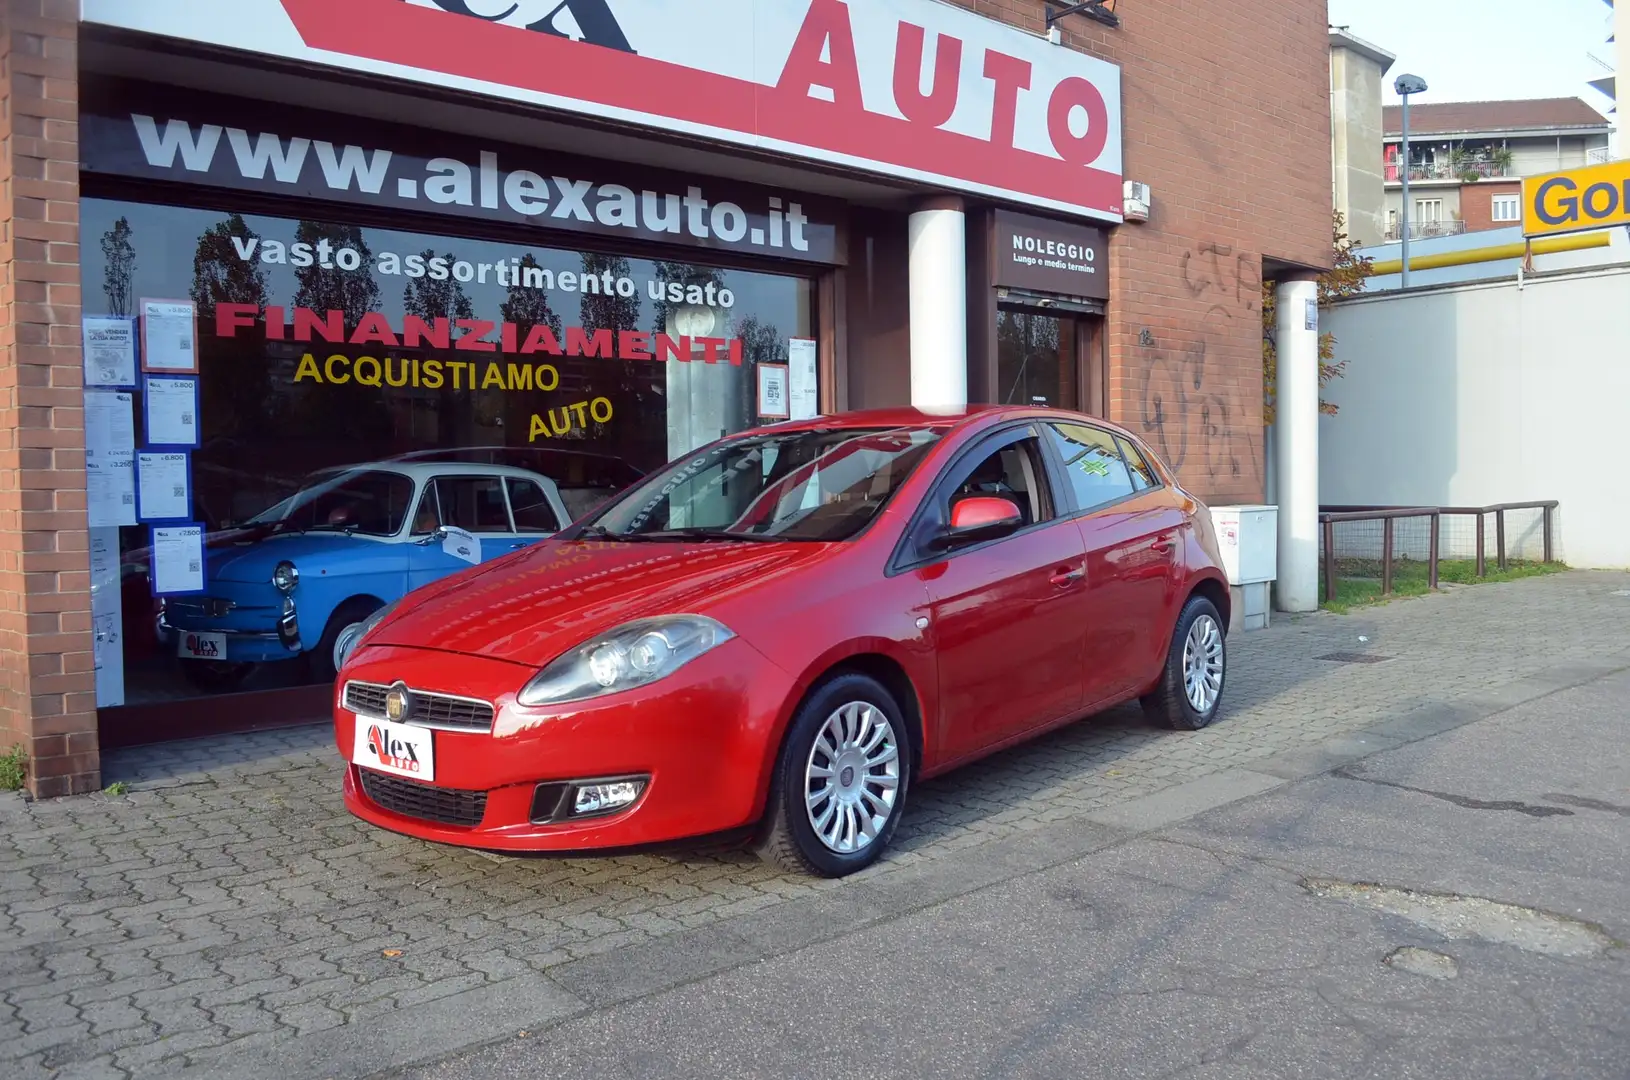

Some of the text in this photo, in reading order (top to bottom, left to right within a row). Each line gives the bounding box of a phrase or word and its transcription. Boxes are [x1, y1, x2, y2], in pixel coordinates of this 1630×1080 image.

[775, 0, 1108, 167] AUTO
[131, 113, 808, 252] www.alexauto.it
[1013, 235, 1094, 262] NOLEGGIO
[1013, 253, 1036, 266] Lungo
[1045, 259, 1066, 269] medio
[1068, 262, 1095, 273] termine
[231, 236, 735, 308] vasto assortimento usato
[215, 302, 744, 367] FINANZIAMENTI
[294, 353, 559, 391] ACQUISTIAMO
[528, 396, 613, 442] AUTO
[366, 724, 418, 762] Alex
[390, 757, 419, 772] AUTO
